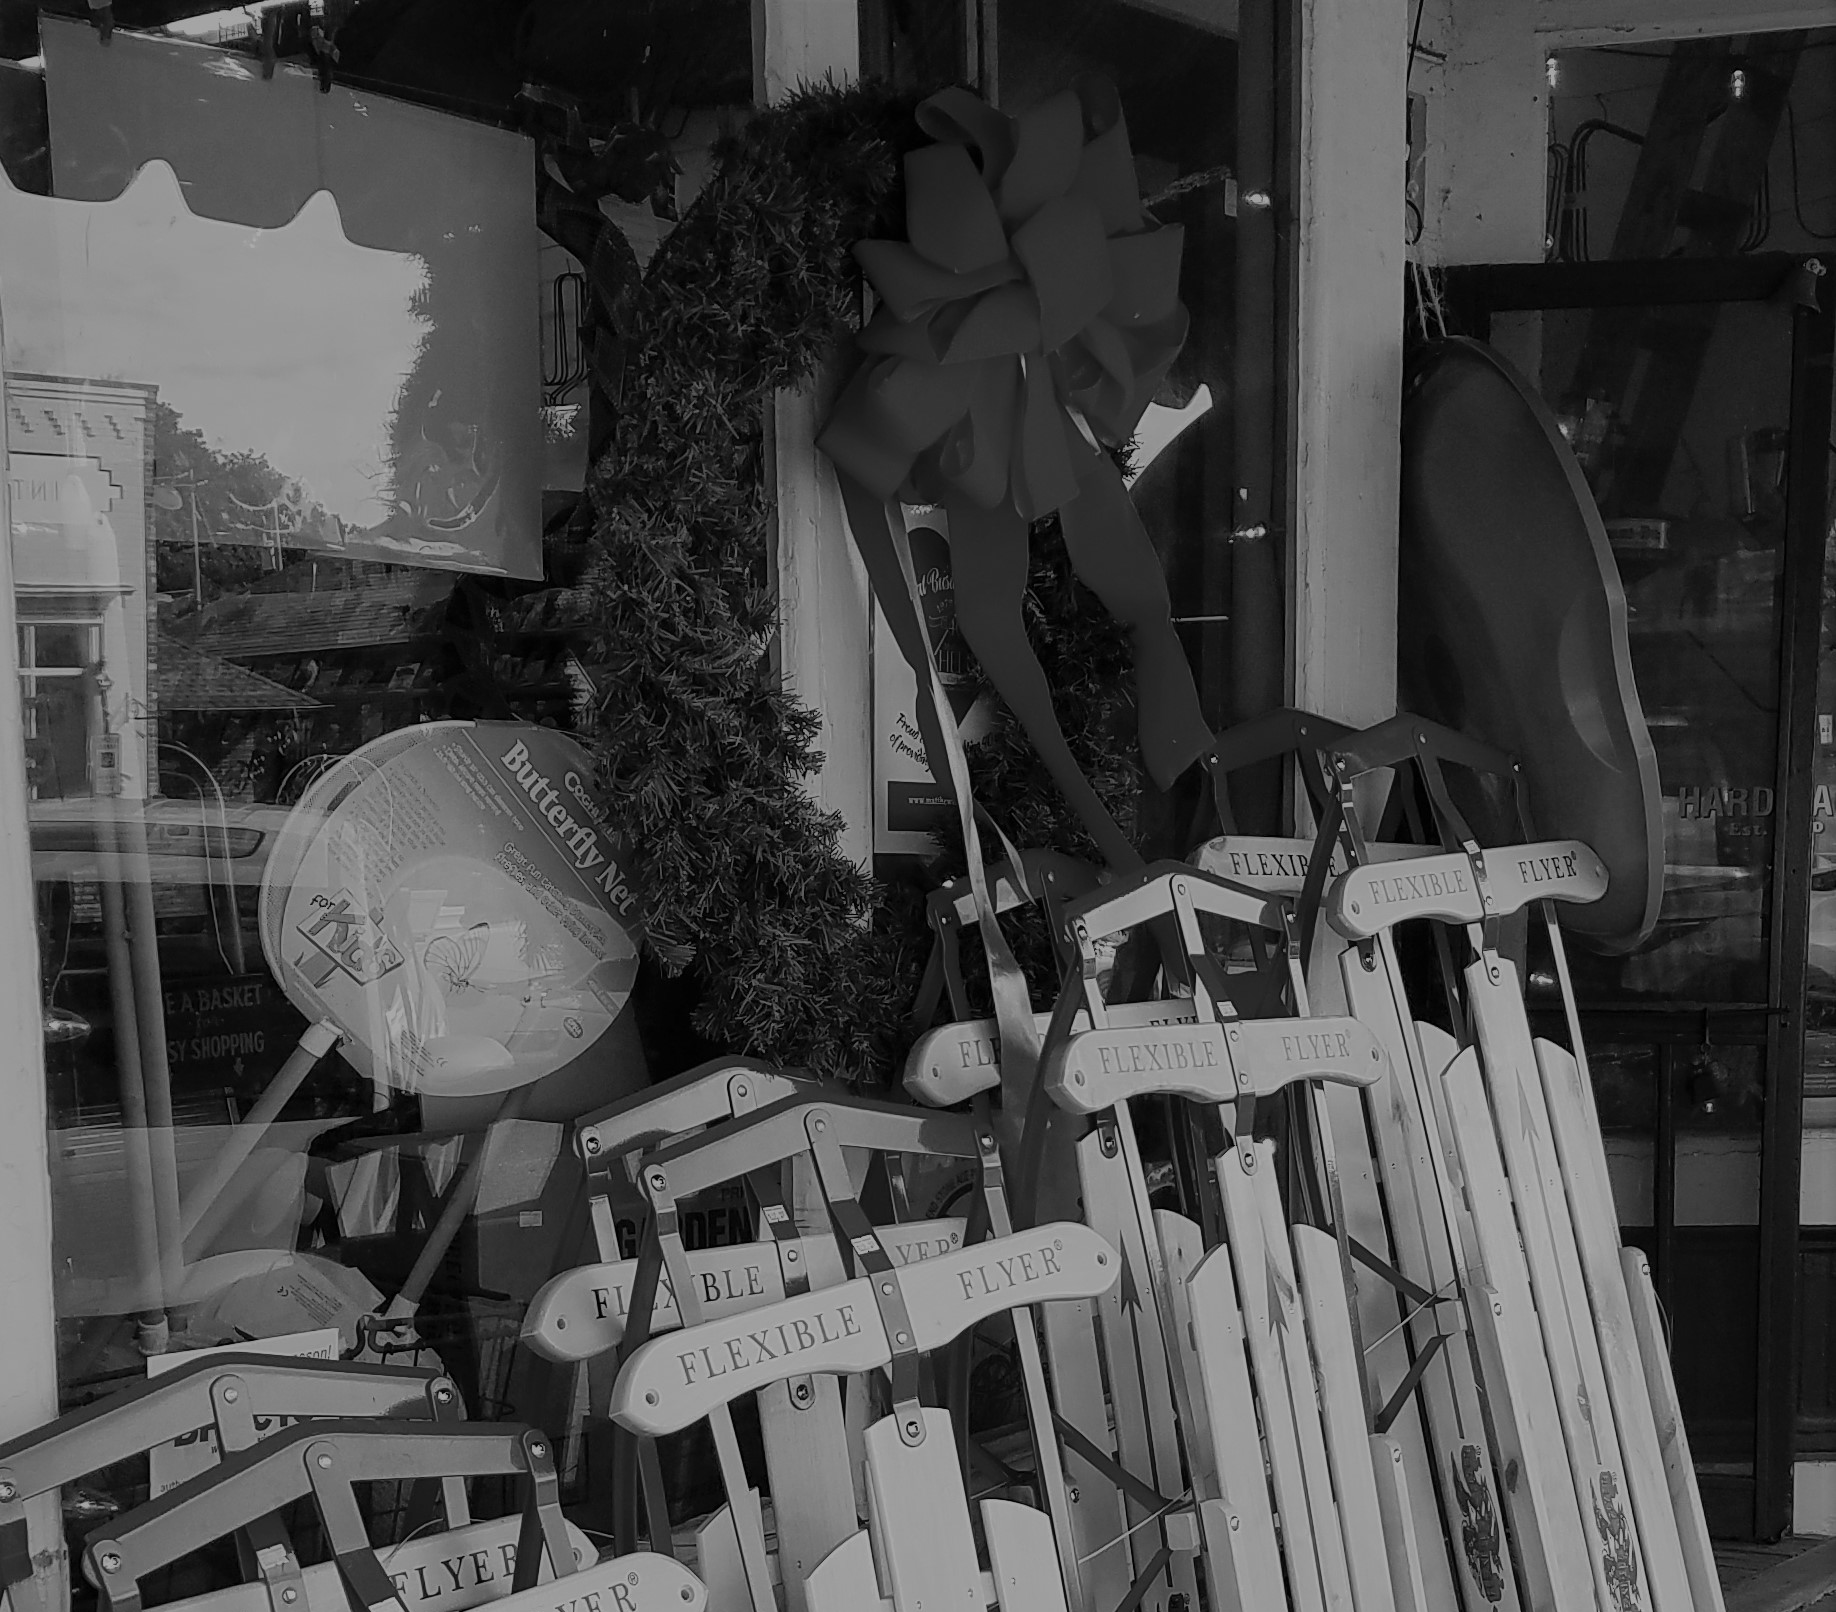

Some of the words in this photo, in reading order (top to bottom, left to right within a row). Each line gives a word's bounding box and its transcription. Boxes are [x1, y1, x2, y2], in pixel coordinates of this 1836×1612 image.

[501, 739, 604, 869] Butterfly
[595, 860, 638, 916] Net
[1229, 853, 1340, 877] FLEXIBE
[310, 894, 335, 910] for
[1368, 869, 1468, 905] FLEXIBLE
[198, 984, 263, 1012] BASKET
[191, 1030, 265, 1061] SHOPPING
[1097, 1041, 1218, 1074] FLEXIBLE
[616, 1206, 752, 1259] GDEN
[676, 1305, 861, 1386] FLEXIBLE
